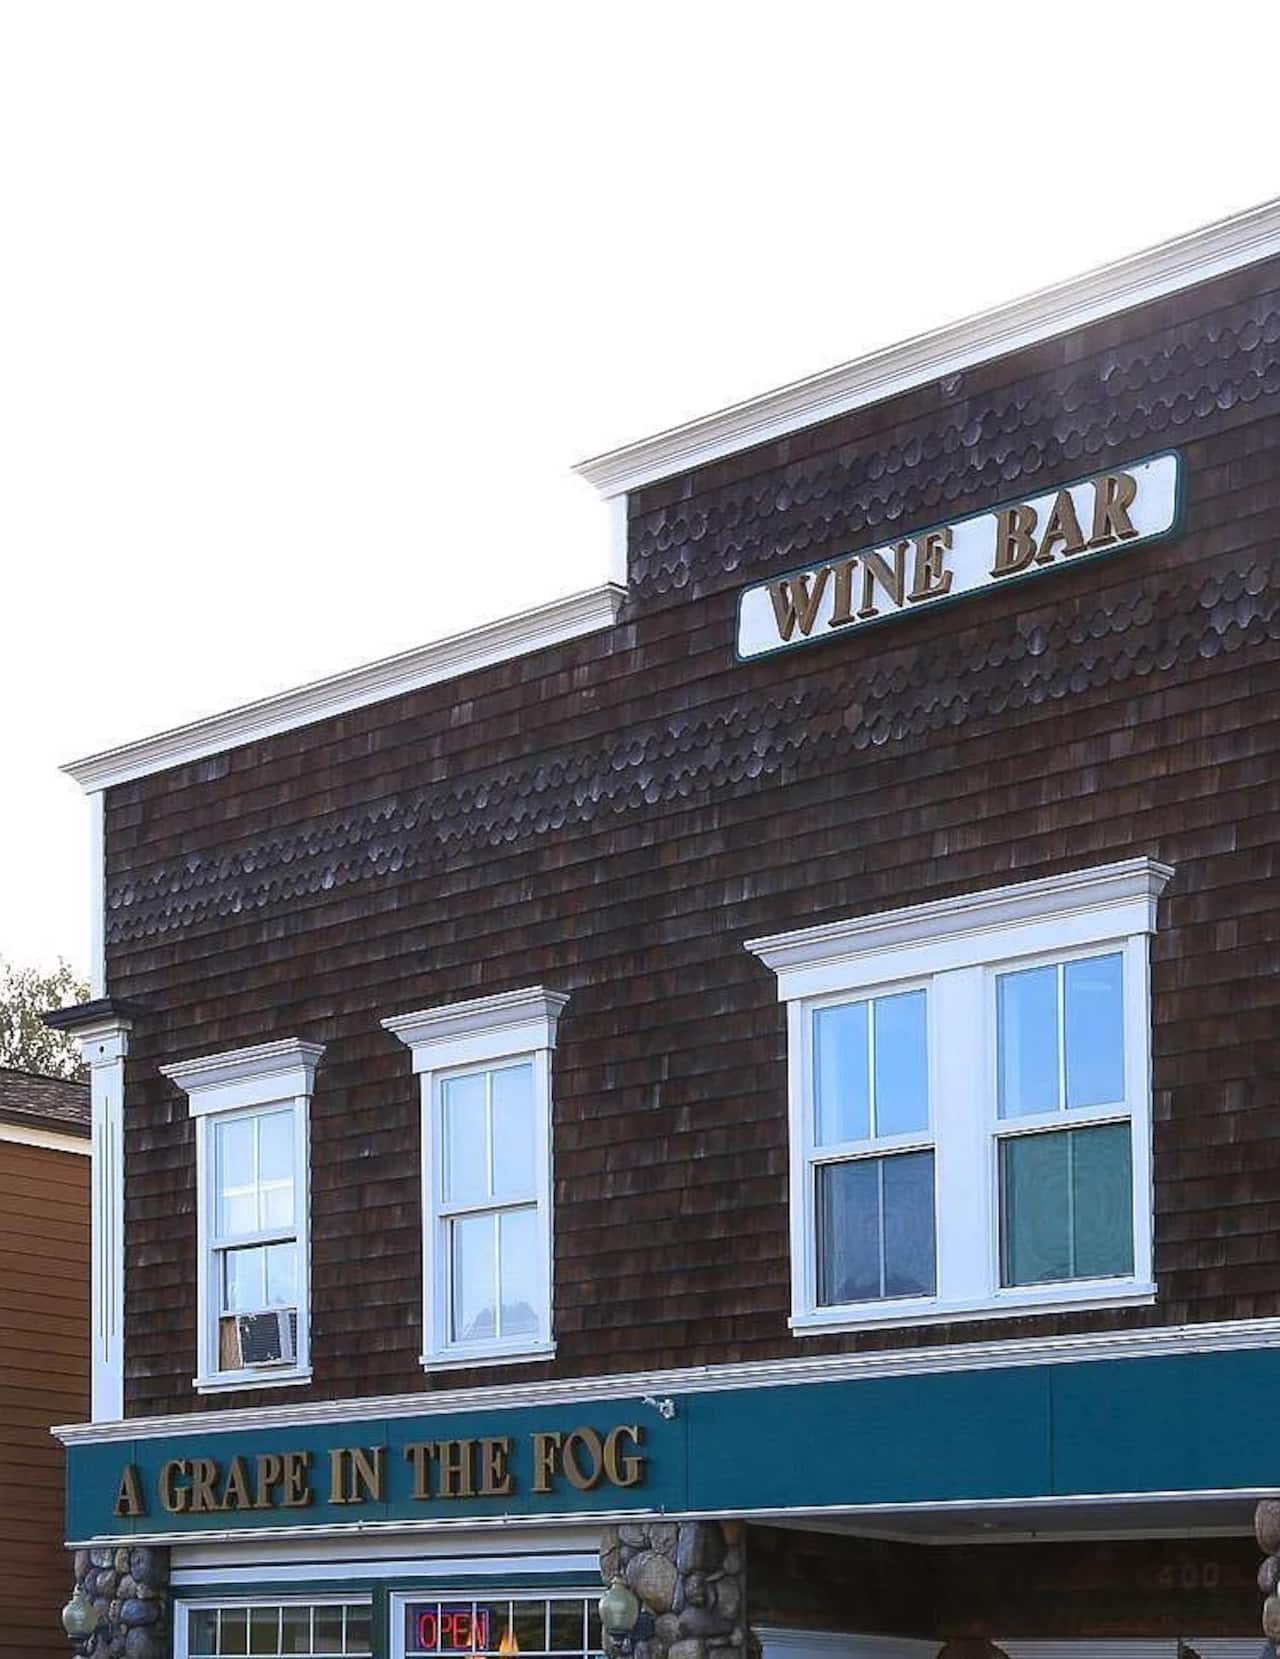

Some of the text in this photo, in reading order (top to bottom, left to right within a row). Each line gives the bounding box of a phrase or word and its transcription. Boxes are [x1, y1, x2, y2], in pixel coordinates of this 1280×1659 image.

[767, 472, 1138, 641] WINE BAR
[113, 1424, 645, 1516] A GRAPE IN THE FOG
[418, 1611, 488, 1649] OPEN
